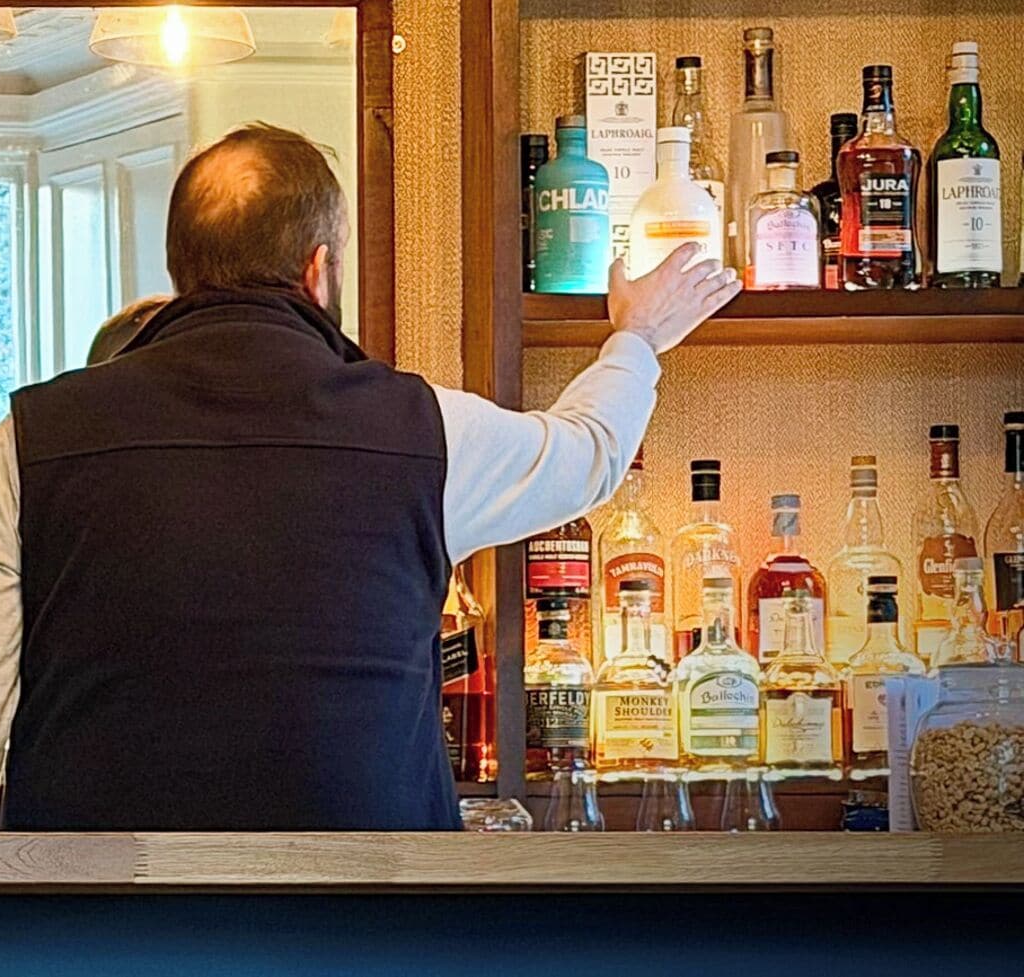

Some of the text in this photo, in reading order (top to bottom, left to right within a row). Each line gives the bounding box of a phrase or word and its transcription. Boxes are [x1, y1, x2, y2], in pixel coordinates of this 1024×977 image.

[613, 165, 631, 179] 10
[861, 178, 910, 192] JURA
[970, 216, 984, 231] 10
[528, 691, 590, 705] ERFELDY
[619, 695, 669, 707] MONKEY
